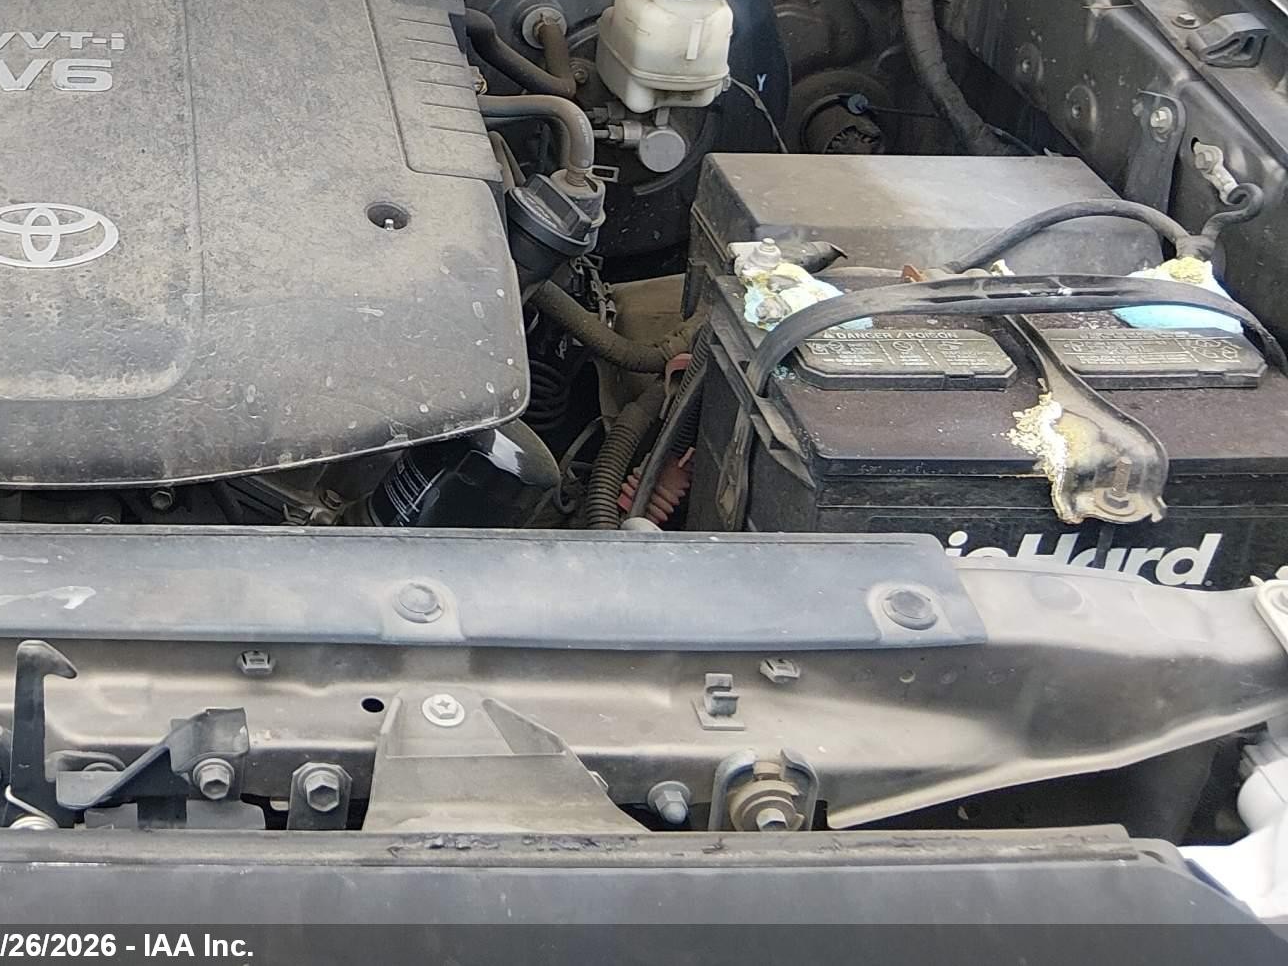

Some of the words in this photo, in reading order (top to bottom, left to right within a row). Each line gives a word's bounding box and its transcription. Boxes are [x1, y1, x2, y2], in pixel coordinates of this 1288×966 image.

[756, 73, 767, 92] Y
[835, 332, 893, 340] DANGER
[905, 332, 960, 340] POISON
